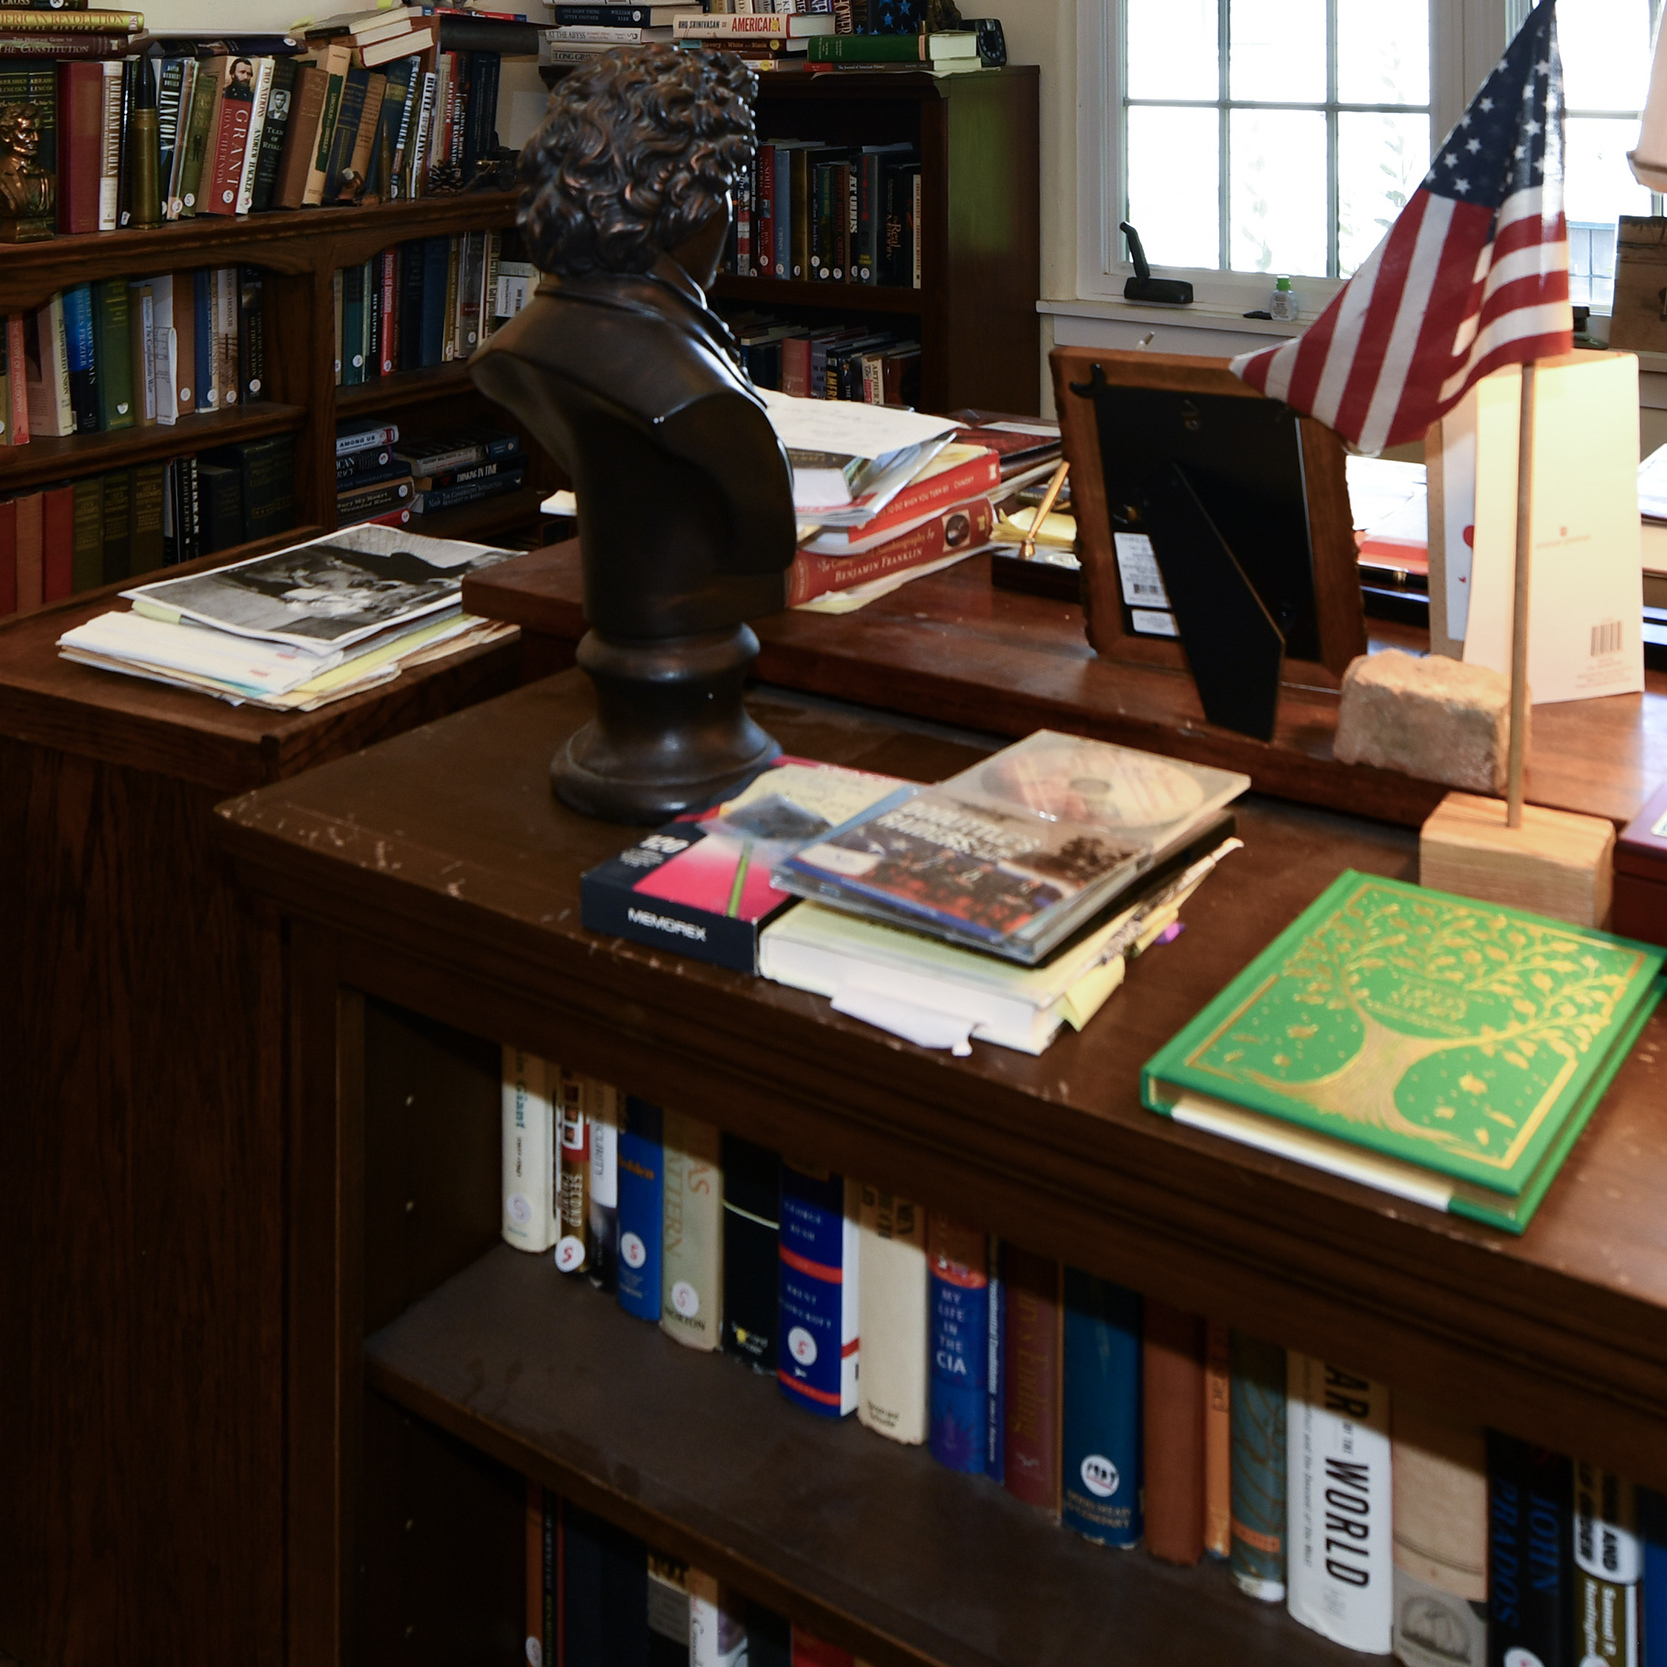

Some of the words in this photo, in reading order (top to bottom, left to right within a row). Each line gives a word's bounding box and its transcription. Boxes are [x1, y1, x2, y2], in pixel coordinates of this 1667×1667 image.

[50, 13, 124, 24] REVOLUTION
[678, 21, 688, 29] BHU
[689, 20, 720, 29] SRINIVASAN
[20, 43, 89, 54] CONSTITUTION
[556, 31, 568, 39] THE
[568, 31, 586, 39] ABYSS
[263, 65, 273, 84] TWO
[109, 77, 122, 130] ABRAHAM
[257, 87, 270, 118] NATIONS
[423, 76, 435, 113] BATTLE
[445, 81, 454, 124] MAVERICK
[159, 90, 180, 151] LINCOLN
[223, 108, 232, 130] RON
[453, 99, 462, 124] GEORGE
[107, 133, 120, 176] LINCOLN
[226, 108, 249, 189] GRANT
[250, 127, 262, 160] ANDREW
[416, 134, 427, 161] LINES
[451, 124, 460, 166] WASHINGTON
[215, 132, 229, 185] CHERNOW
[244, 161, 257, 194] HACKER
[848, 174, 858, 194] AT
[848, 195, 858, 234] ODDS
[891, 222, 902, 248] Real
[11, 322, 19, 336] THE
[12, 337, 21, 359] STORY
[78, 328, 87, 367] FRAZIER
[86, 321, 96, 385] MOUNTAIN
[13, 360, 21, 369] OF
[14, 371, 23, 413] PHILOSOPHY
[61, 370, 69, 395] UNION
[339, 438, 365, 448] AMONG
[190, 458, 200, 535] SHERMAN
[366, 492, 388, 502] Heart
[373, 497, 393, 506] Knee
[903, 499, 918, 510] WHEN
[918, 495, 929, 504] YOU
[929, 490, 942, 500] TURN
[834, 559, 880, 584] BENJAMIN
[881, 546, 925, 570] FRANKLIN
[639, 833, 690, 855] 120
[627, 906, 709, 943] MEMOREX
[569, 1174, 582, 1227] SECOND
[783, 1199, 821, 1226] GEORGE
[789, 1222, 815, 1242] BUSH
[786, 1282, 817, 1306] BRENT
[942, 1287, 962, 1304] MY
[937, 1303, 965, 1323] LIFE
[942, 1321, 958, 1335] IN
[937, 1333, 964, 1354] THE
[935, 1350, 966, 1376] CIA
[1325, 1364, 1370, 1420] AR
[1324, 1457, 1370, 1590] WORLD
[1490, 1478, 1520, 1630] PRADOS
[1528, 1496, 1559, 1596] JOHN
[1601, 1530, 1619, 1573] AND
[1583, 1579, 1599, 1658] Huntington
[1601, 1585, 1617, 1640] Samuel
[1602, 1642, 1616, 1656] P.
